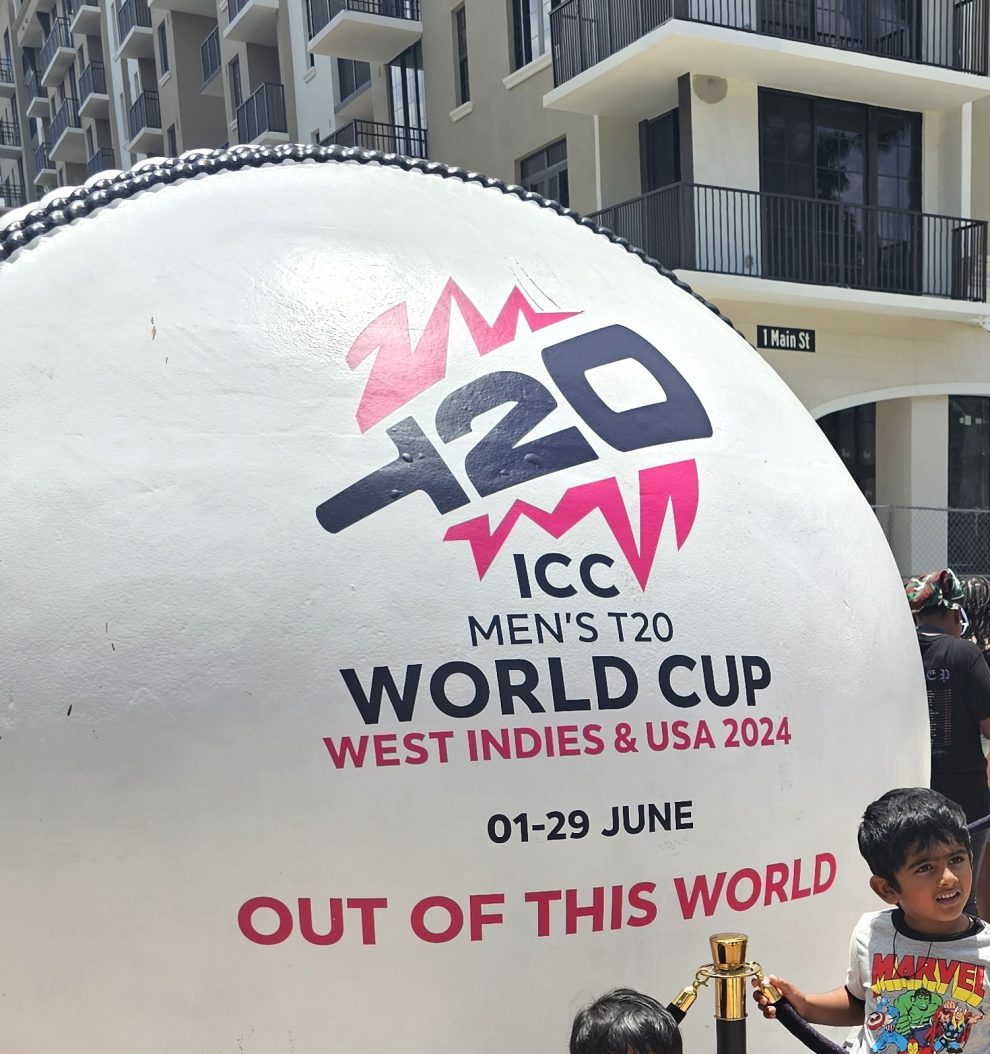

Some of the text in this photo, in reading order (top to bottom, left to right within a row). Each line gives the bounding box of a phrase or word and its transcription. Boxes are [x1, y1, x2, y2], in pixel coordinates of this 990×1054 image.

[763, 328, 810, 350] 1 Main St
[315, 323, 714, 534] T20
[512, 553, 621, 599] ICC
[467, 611, 674, 647] MEN'S T20
[338, 654, 772, 725] WORLD CUP
[324, 715, 792, 769] WEST INDIES & USA 2024
[487, 800, 694, 844] 01-29 JUNE
[238, 852, 838, 946] OUT OF THIS WORLD
[871, 953, 985, 1003] MARVEL
